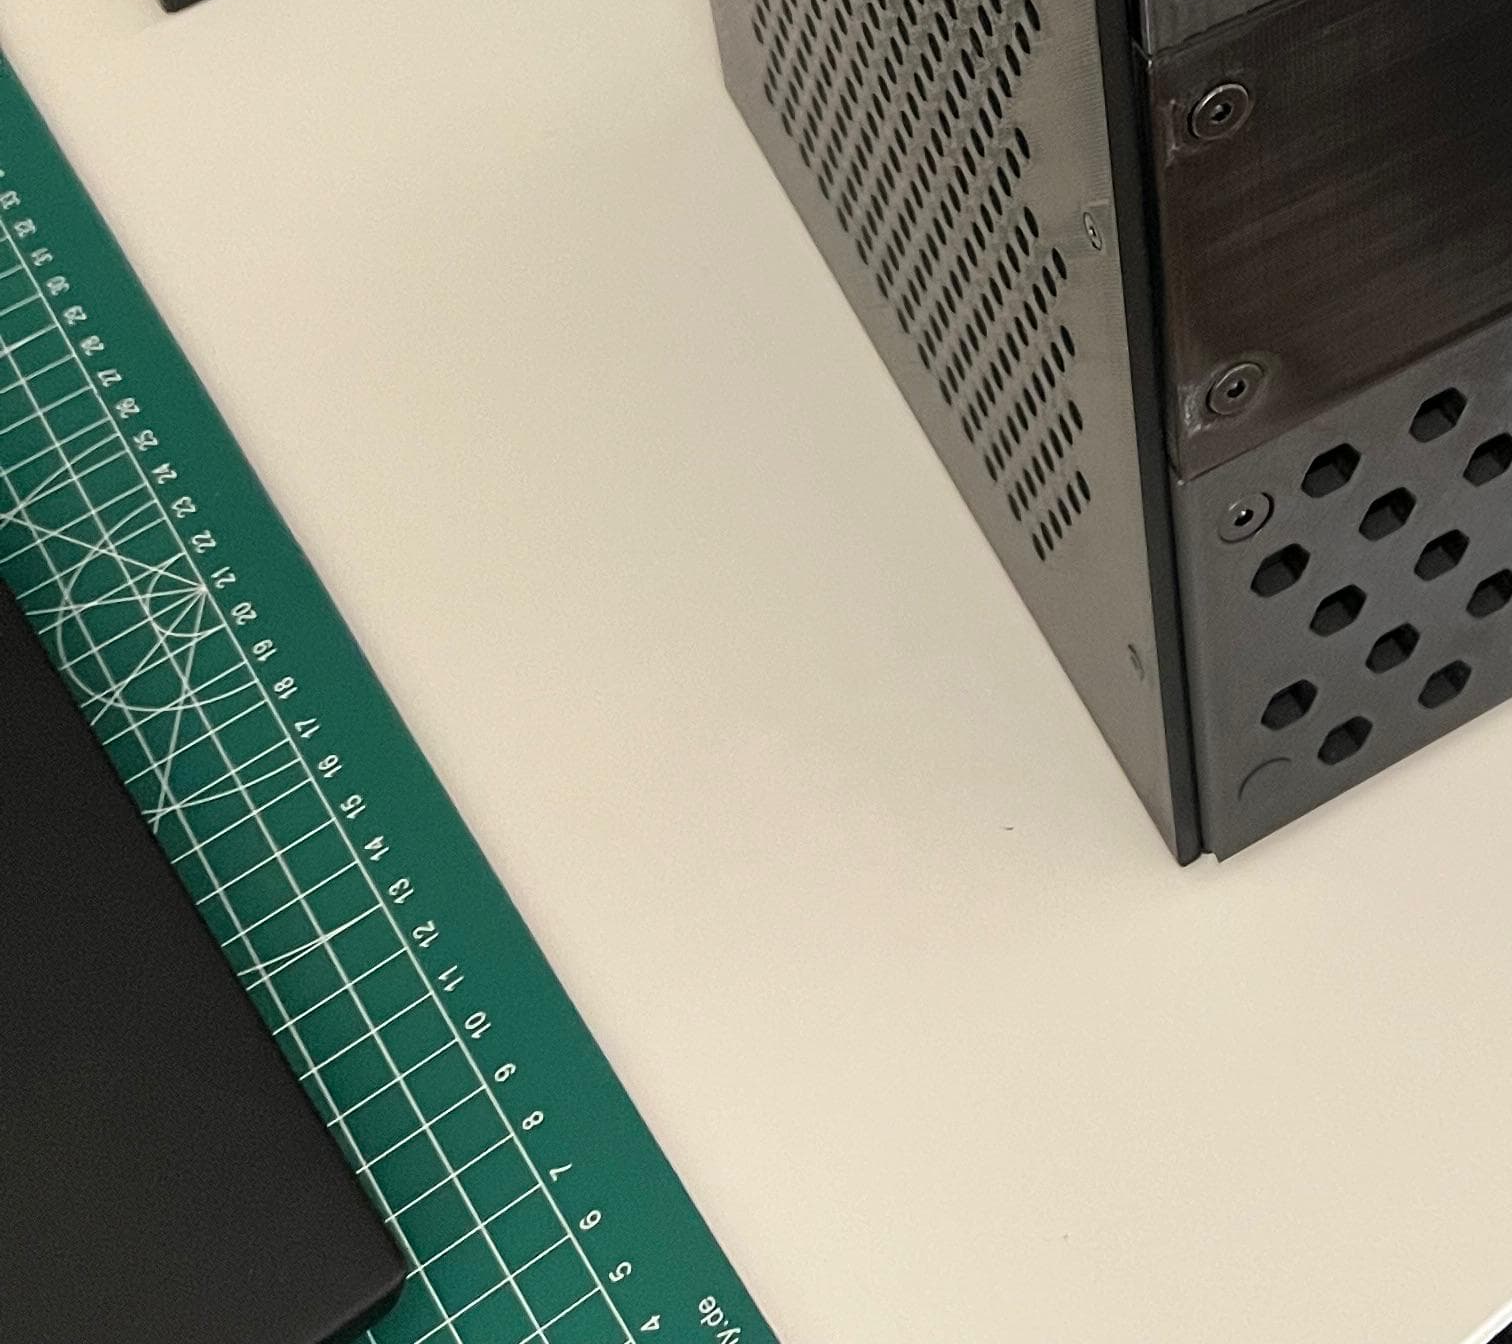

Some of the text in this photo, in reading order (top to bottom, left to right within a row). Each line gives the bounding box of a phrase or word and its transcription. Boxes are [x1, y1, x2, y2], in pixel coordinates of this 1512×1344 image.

[46, 275, 70, 296] 30
[63, 305, 88, 326] 29
[79, 335, 105, 357] 28
[96, 369, 123, 388] 27
[115, 397, 141, 419] 26
[133, 429, 159, 452] 25
[151, 462, 178, 485] 24
[170, 496, 197, 519] 23
[191, 529, 217, 554] 22
[210, 566, 236, 589] 21
[230, 602, 258, 626] 20
[252, 639, 277, 662] 19
[273, 676, 298, 700] 18
[294, 718, 320, 739] 17
[317, 754, 343, 778] 16
[339, 794, 366, 819] 15
[364, 835, 390, 861] 14
[388, 878, 414, 904] 13
[412, 920, 439, 948] 12
[437, 964, 465, 992] 11
[464, 1011, 492, 1039] 10
[494, 1062, 517, 1082] 9
[521, 1110, 544, 1131] 8
[548, 1163, 573, 1182] 7
[578, 1209, 602, 1231] 6
[608, 1261, 632, 1283] 5
[639, 1314, 661, 1332] 4
[698, 1294, 742, 1344] y.de
